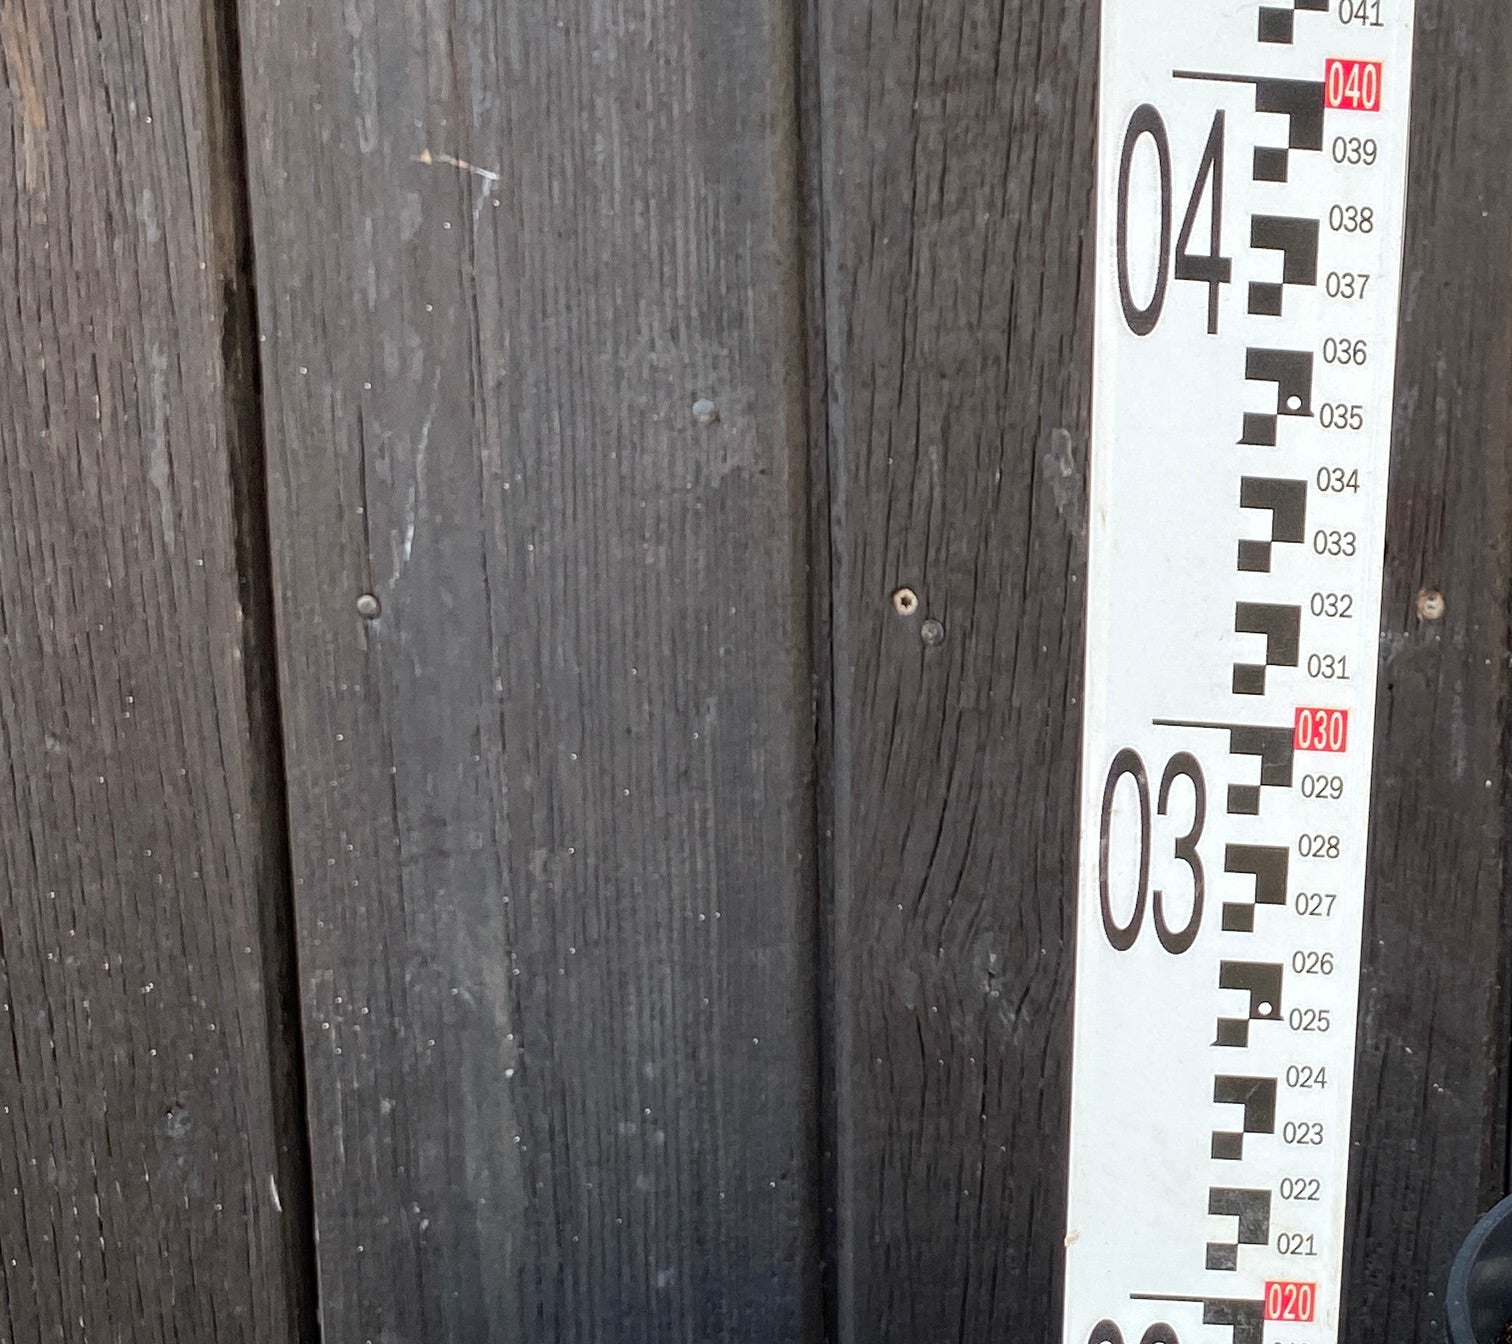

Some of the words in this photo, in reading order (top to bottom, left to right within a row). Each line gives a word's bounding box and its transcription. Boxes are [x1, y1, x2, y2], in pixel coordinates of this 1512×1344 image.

[1327, 62, 1377, 108] 040
[1332, 136, 1377, 165] 039
[1117, 103, 1231, 336] 04
[1330, 205, 1373, 233] 038
[1326, 272, 1370, 299] 037
[1323, 338, 1367, 365] 036
[1320, 403, 1363, 430] 035
[1317, 467, 1360, 493] 034
[1314, 530, 1356, 556] 033
[1311, 593, 1352, 618] 032
[1308, 654, 1349, 679] 031
[1297, 710, 1343, 749] 030
[1302, 775, 1343, 799] 029
[1099, 747, 1205, 955] 03
[1299, 834, 1339, 858] 028
[1295, 893, 1336, 916] 027
[1292, 951, 1334, 975] 026
[1289, 1008, 1330, 1032] 025
[1286, 1065, 1327, 1088] 024
[1283, 1122, 1323, 1145] 023
[1280, 1178, 1320, 1201] 022
[1277, 1233, 1317, 1255] 021
[1268, 1285, 1311, 1320] 020
